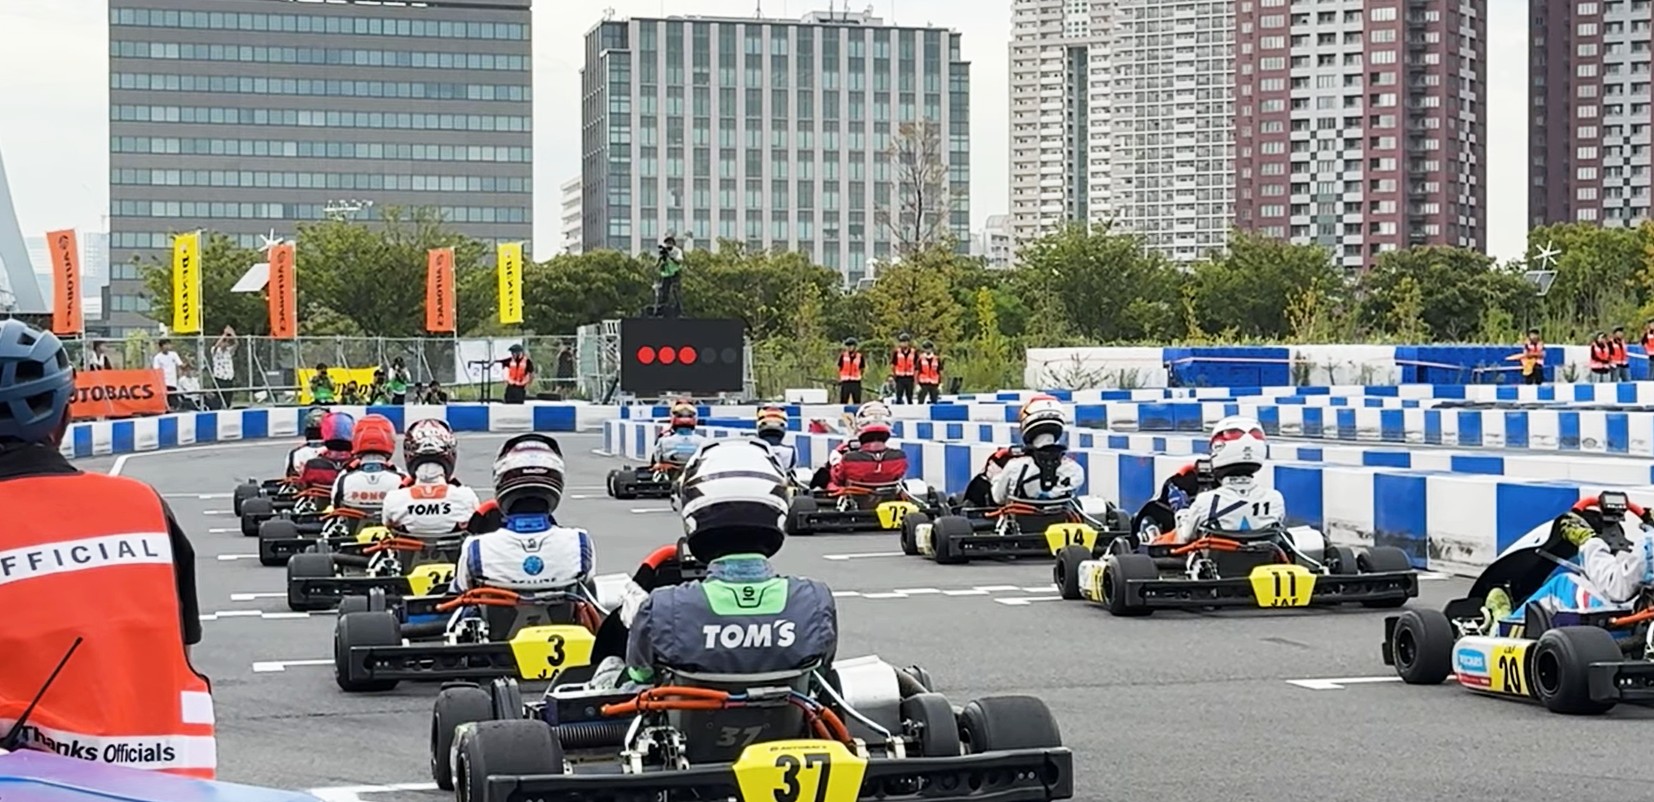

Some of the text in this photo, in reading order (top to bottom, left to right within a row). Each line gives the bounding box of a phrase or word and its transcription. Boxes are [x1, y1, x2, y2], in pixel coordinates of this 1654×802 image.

[407, 501, 451, 515] TOM'S
[1252, 501, 1270, 516] 11
[1063, 529, 1085, 547] 14
[1272, 571, 1296, 597] 11
[703, 619, 796, 649] TOM'S
[547, 634, 565, 667] 3
[1499, 655, 1521, 693] 20
[103, 743, 175, 763] Officials
[773, 753, 831, 802] 37
